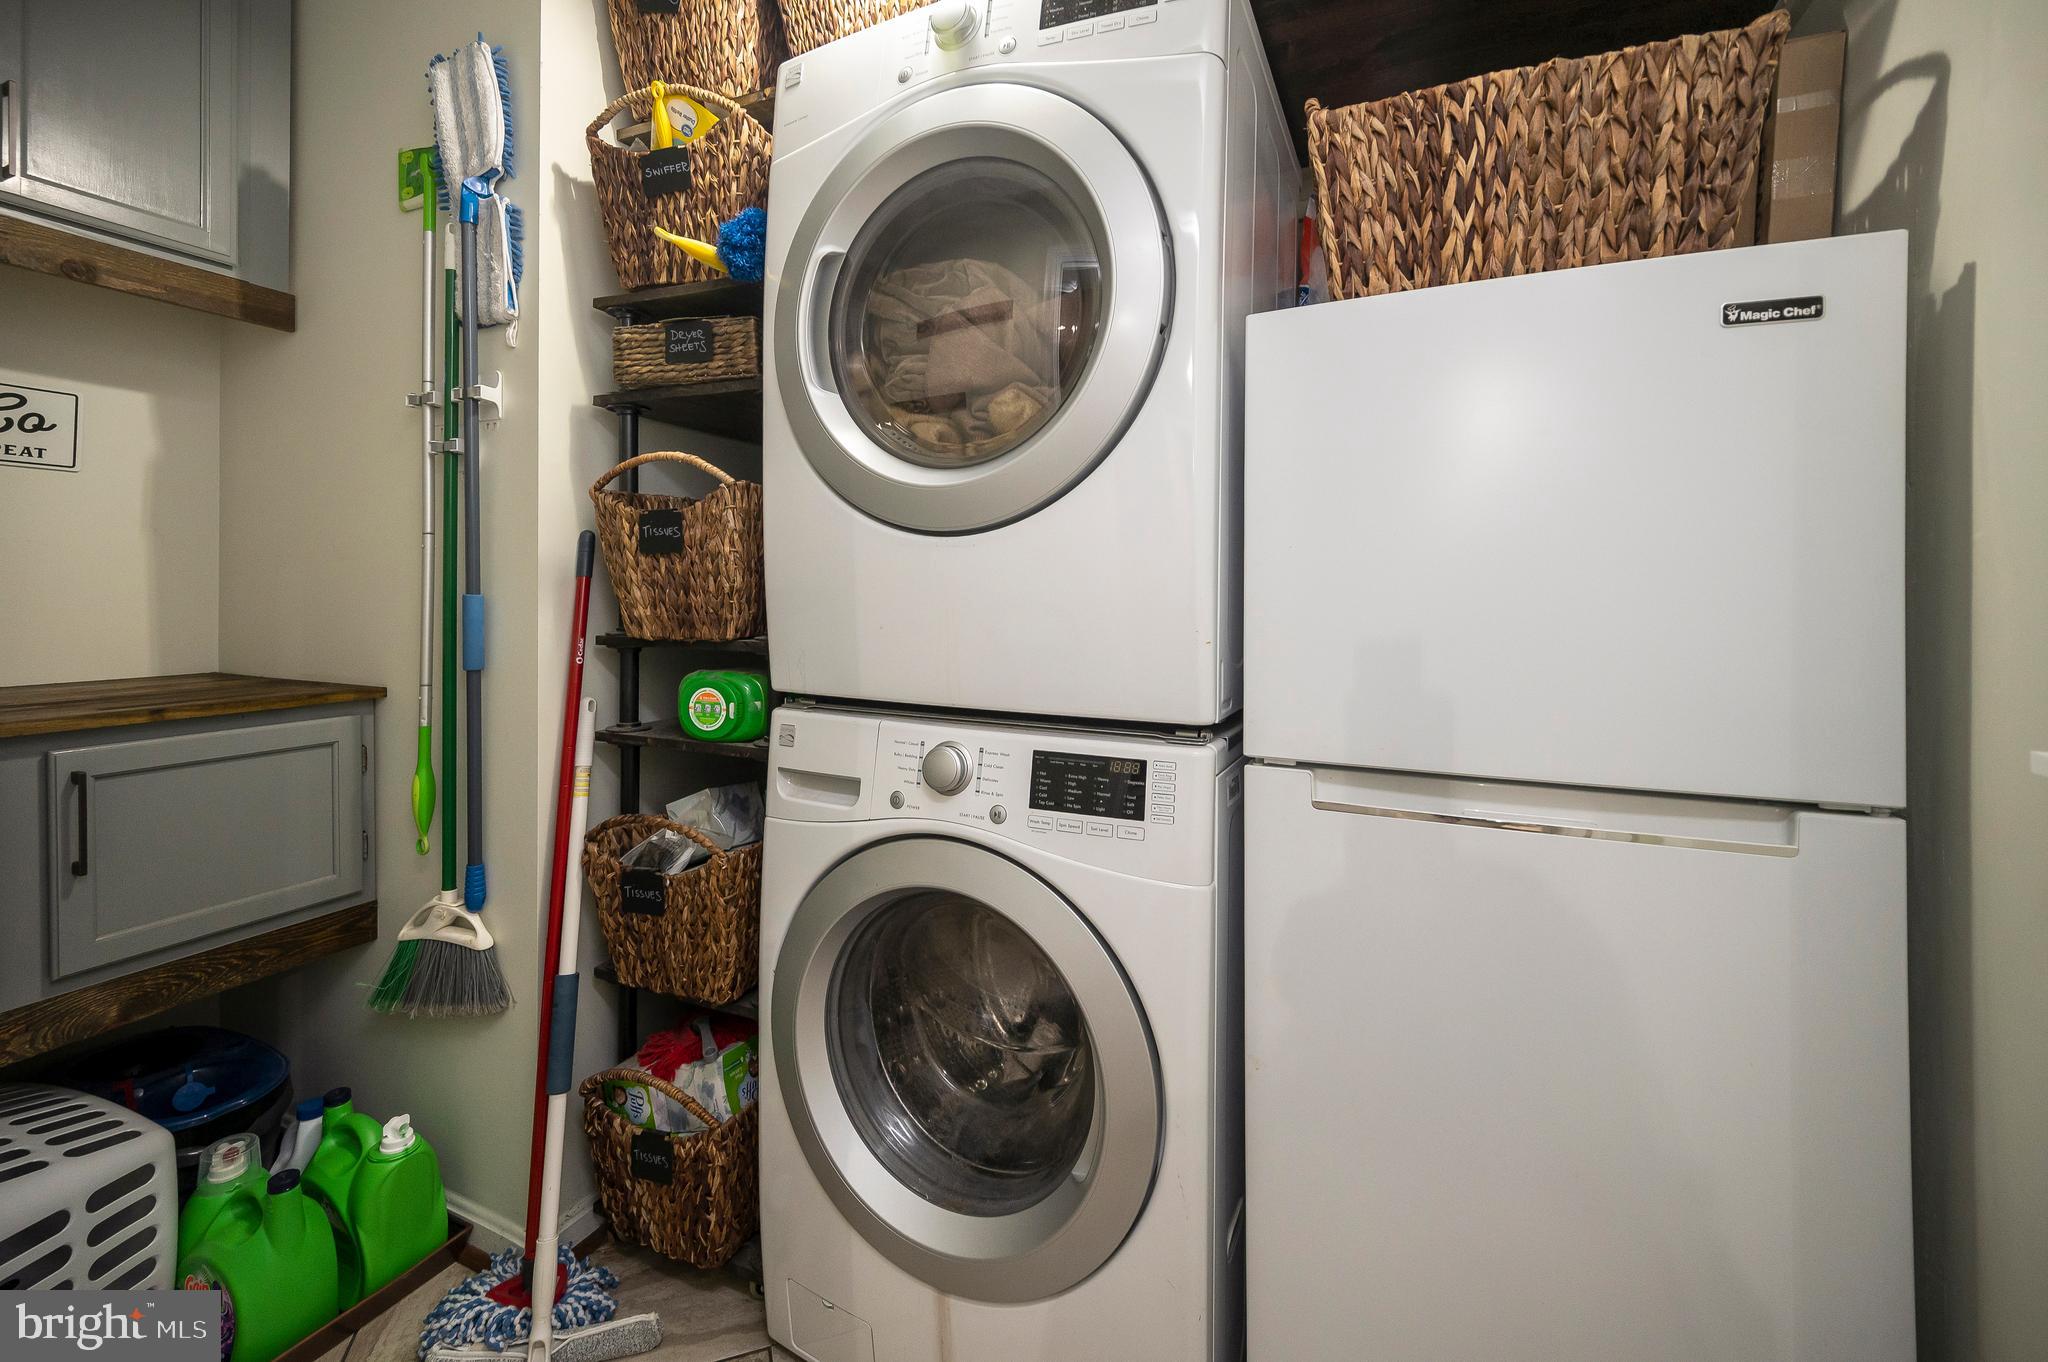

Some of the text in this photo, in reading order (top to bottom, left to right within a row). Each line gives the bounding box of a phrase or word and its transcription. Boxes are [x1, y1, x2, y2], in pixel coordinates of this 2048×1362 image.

[1740, 305, 1817, 320] Magic Chef
[670, 330, 705, 345] DRYER
[669, 341, 706, 352] SHEETS
